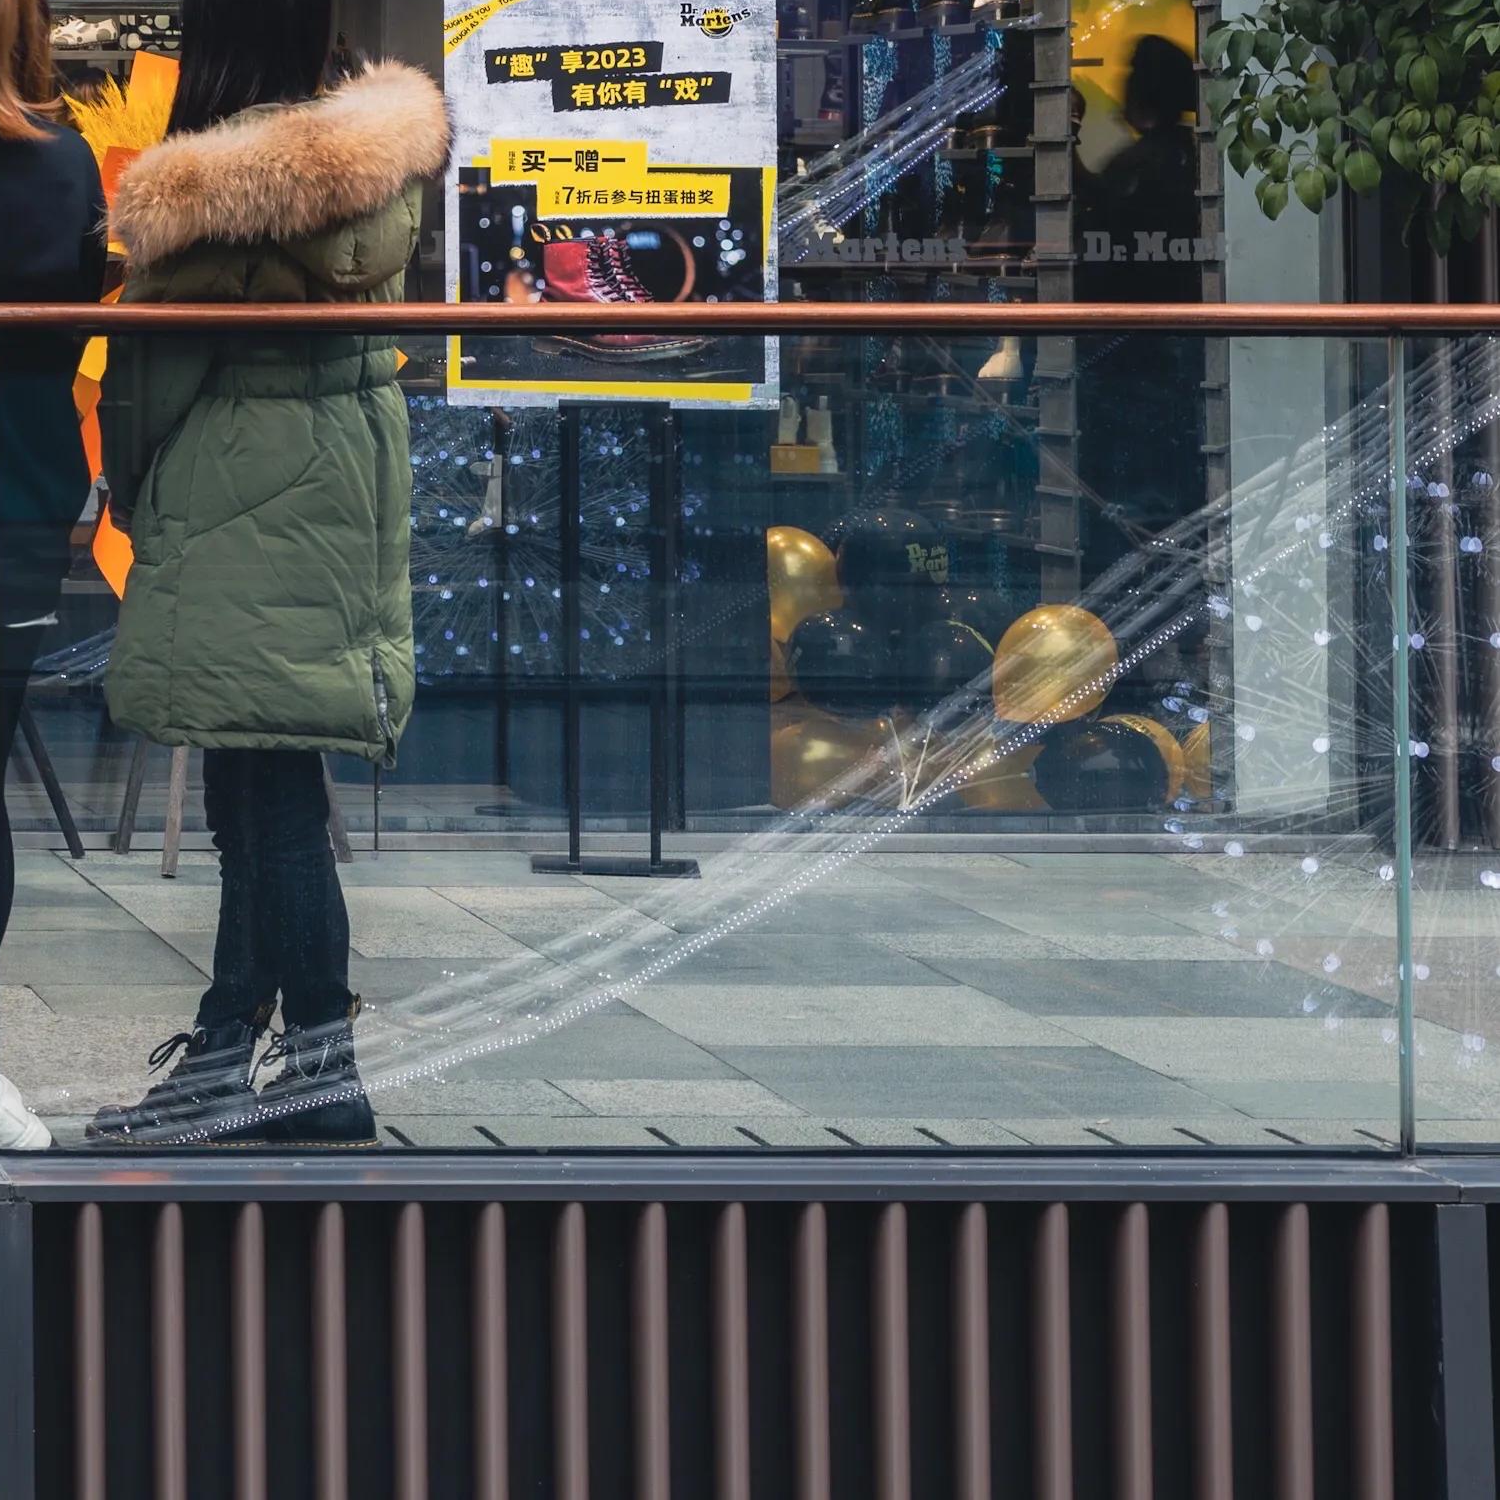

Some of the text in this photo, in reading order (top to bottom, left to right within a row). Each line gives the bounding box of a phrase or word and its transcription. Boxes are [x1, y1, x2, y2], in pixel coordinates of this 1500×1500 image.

[443, 19, 463, 31] OUGH
[464, 12, 474, 22] AS
[476, 5, 491, 16] YOU
[680, 8, 752, 27] Martens
[448, 20, 479, 47] TOUGH AS
[521, 149, 626, 173] 买一赠一
[561, 186, 714, 205] 7折后参与扭蛋抽奖
[806, 231, 968, 263] Martens
[1082, 231, 1127, 262] Dr.
